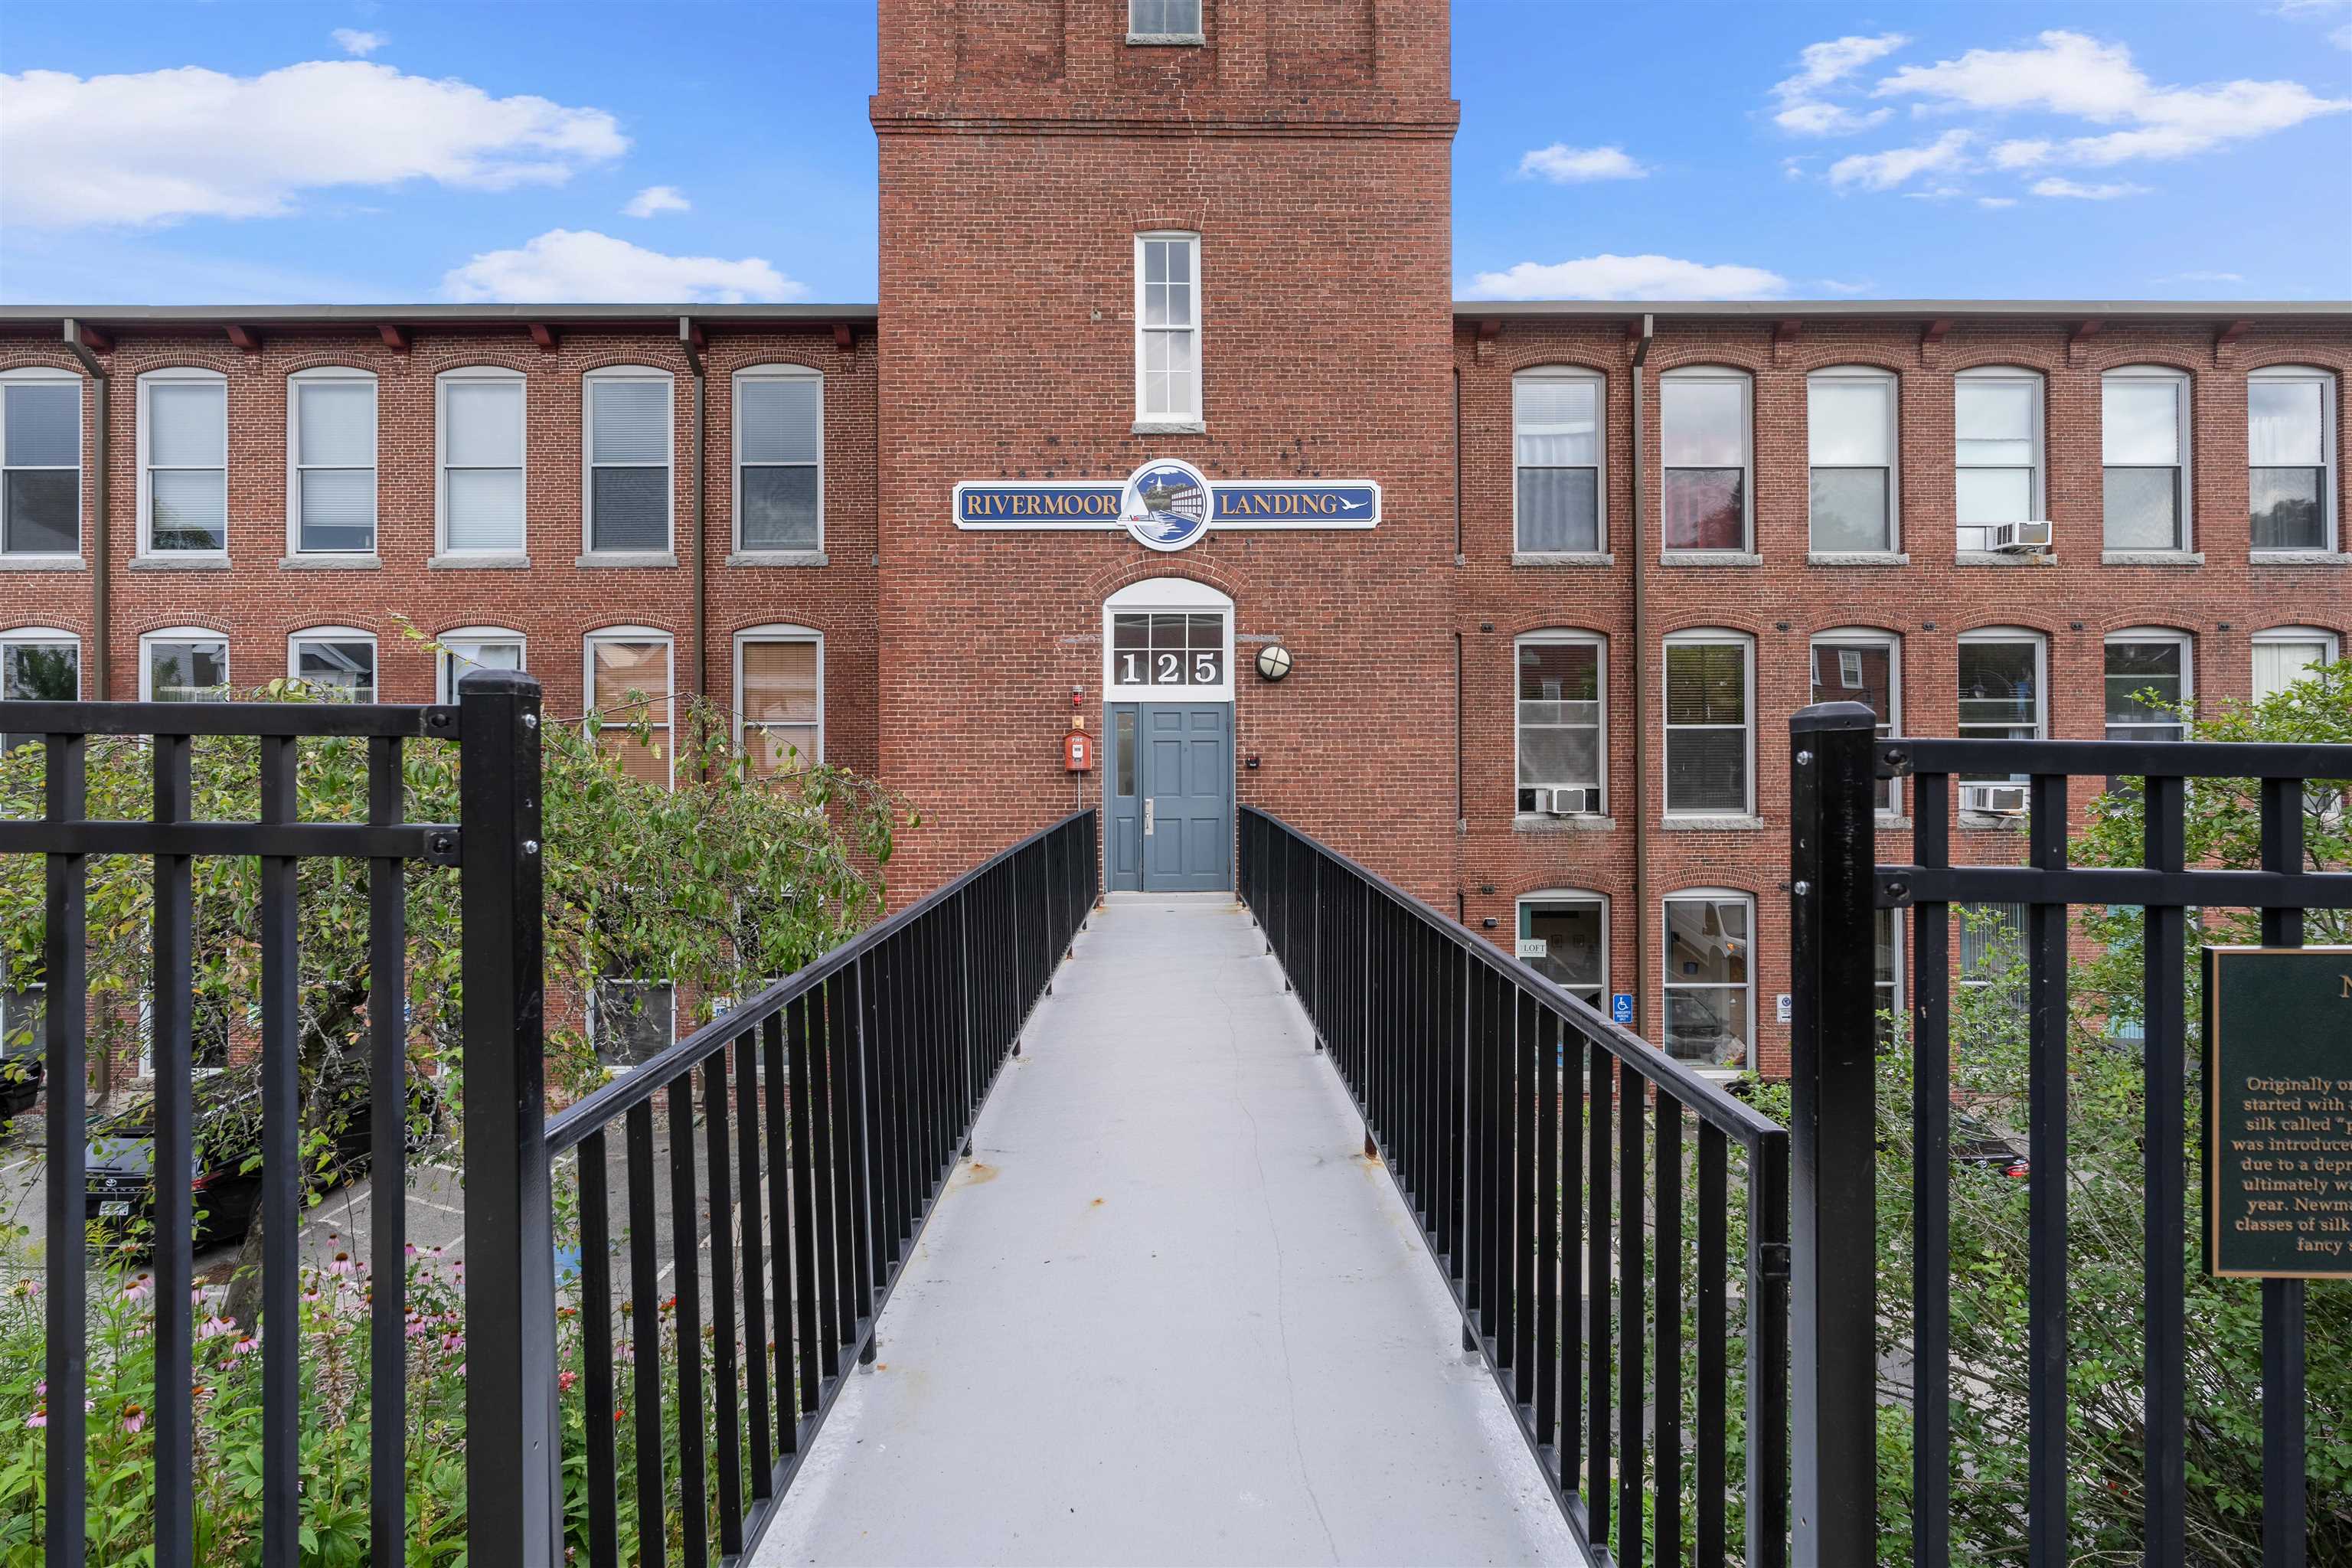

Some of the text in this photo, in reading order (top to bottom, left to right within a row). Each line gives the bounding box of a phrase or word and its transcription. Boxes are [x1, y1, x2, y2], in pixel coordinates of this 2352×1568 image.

[966, 494, 1338, 515] RIVERMOOR LANDING
[1122, 652, 1217, 682] 125
[2246, 1076, 2331, 1095] Originally
[2243, 1097, 2301, 1111] started
[2306, 1097, 2344, 1111] with
[2246, 1116, 2276, 1131] silk
[2281, 1116, 2331, 1131] called
[2232, 1139, 2264, 1151] was
[2241, 1157, 2272, 1171] due
[2277, 1158, 2295, 1171] to
[2298, 1161, 2308, 1171] a
[2243, 1176, 2328, 1194] ultimately
[2247, 1200, 2288, 1214] year.
[2235, 1217, 2350, 1231] classes of silk
[2298, 1236, 2342, 1256] fancy
